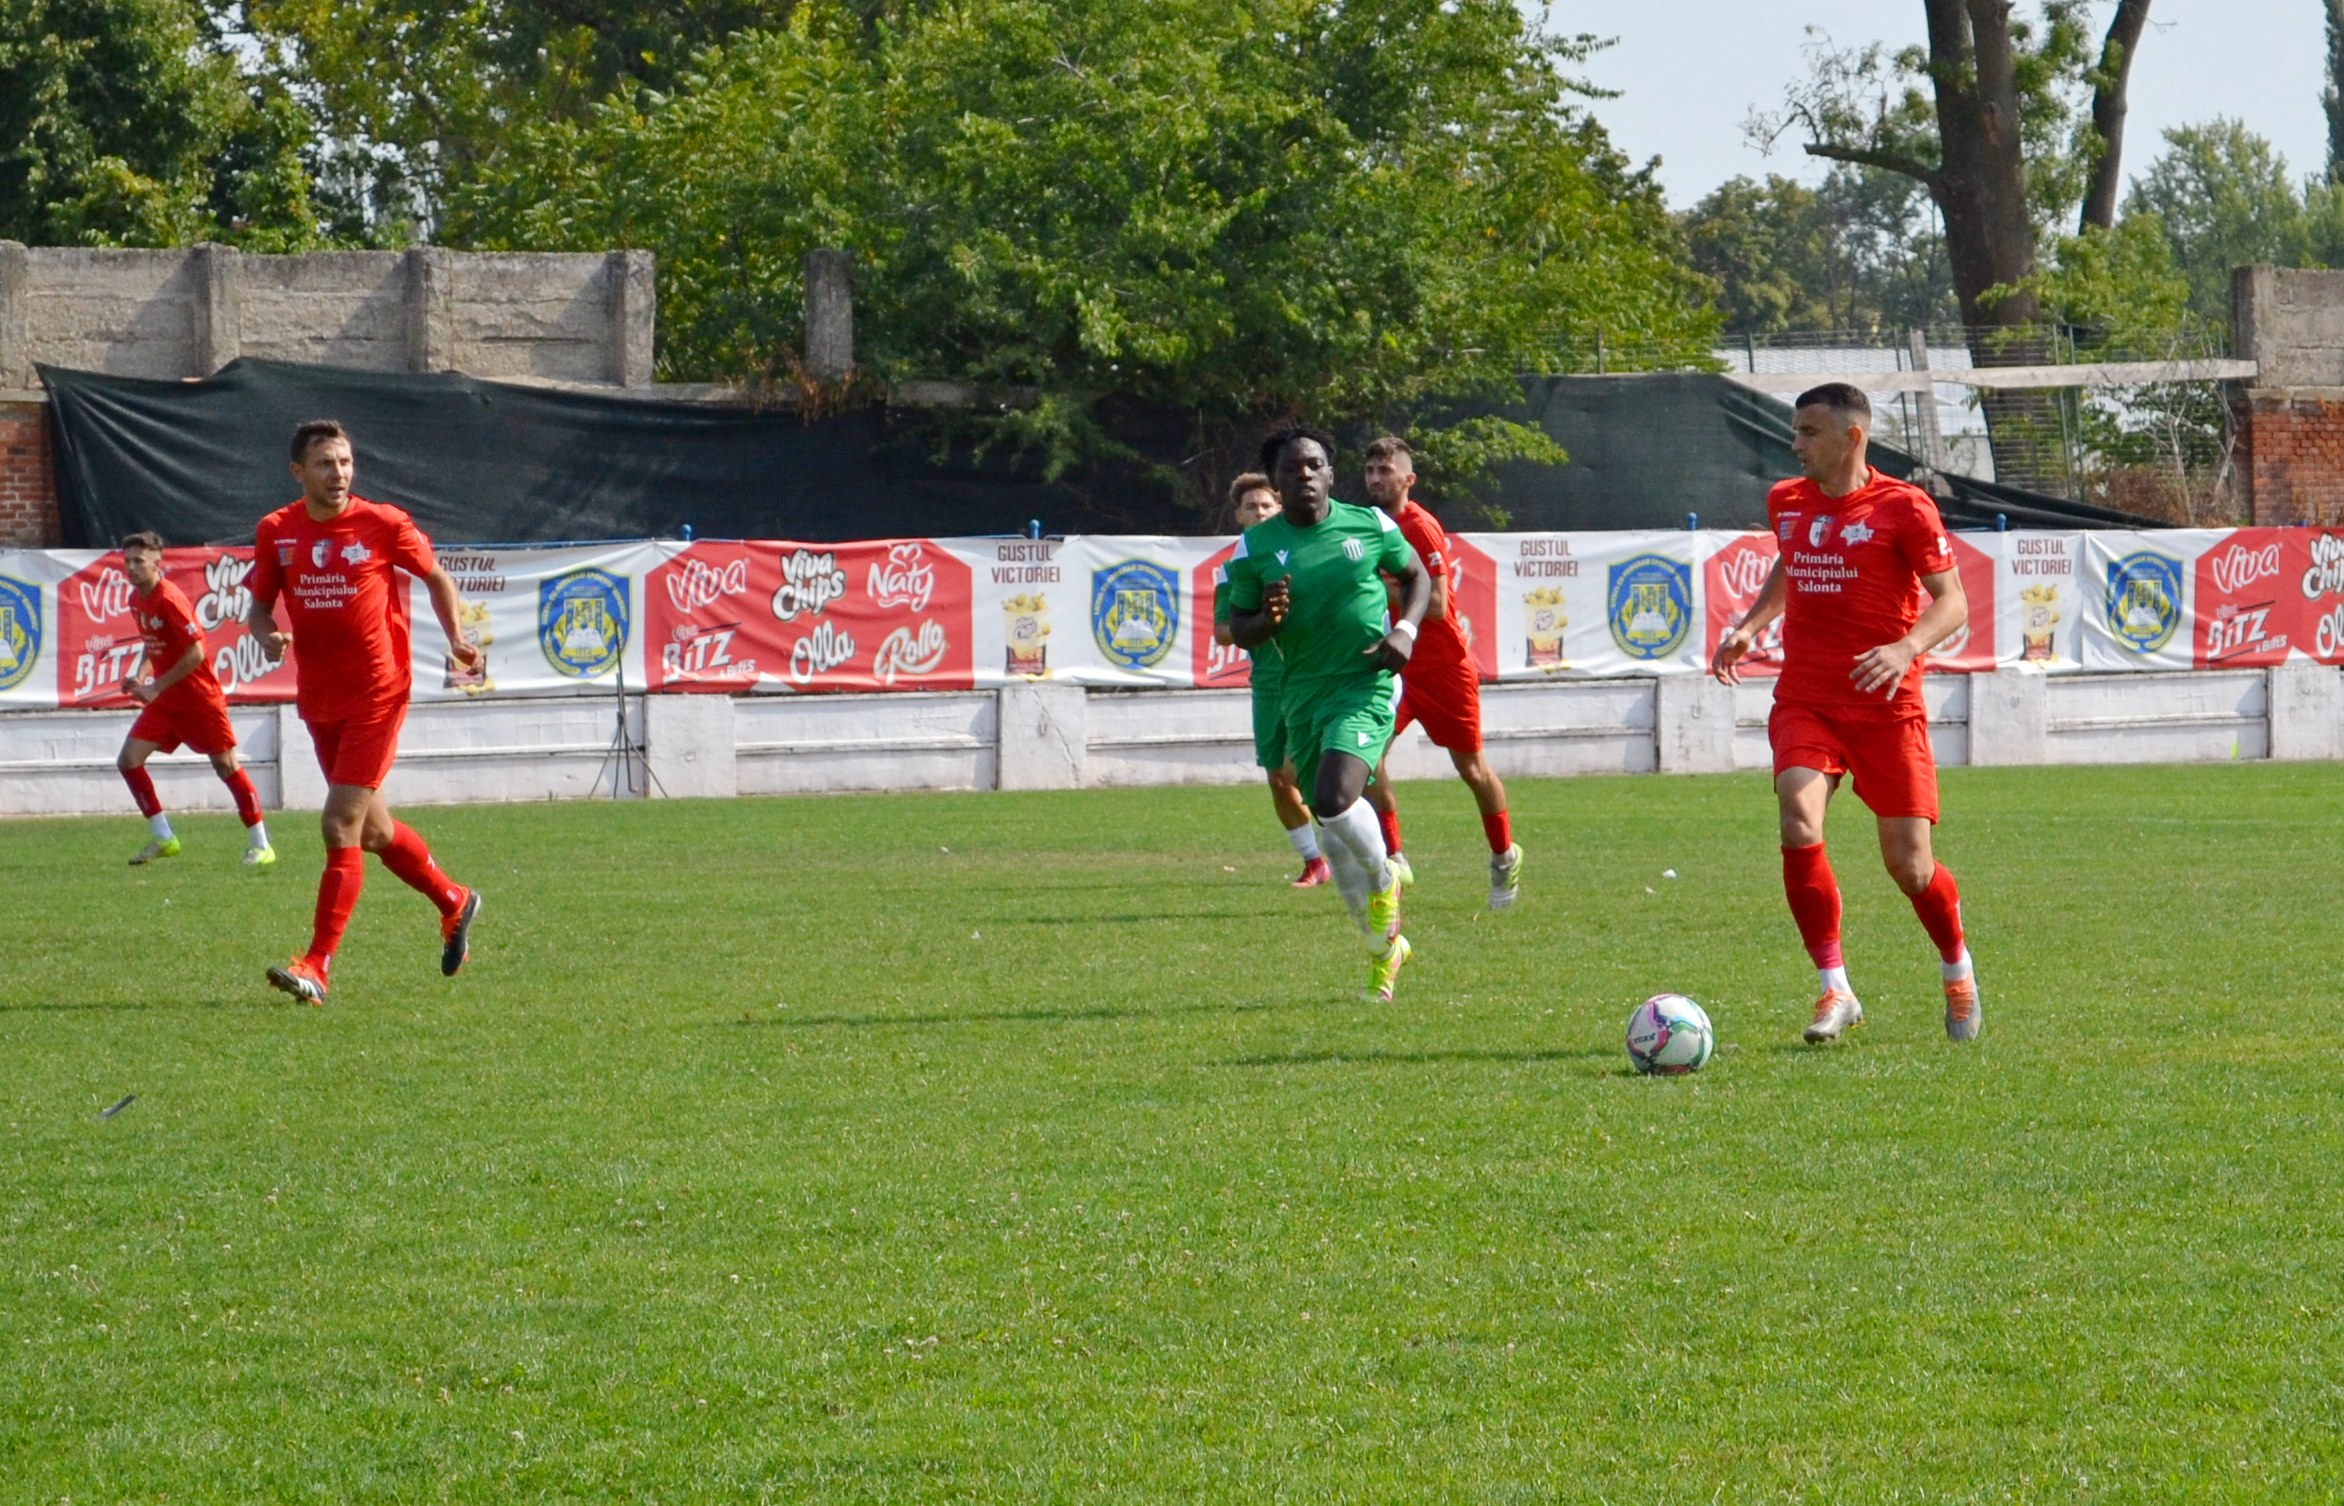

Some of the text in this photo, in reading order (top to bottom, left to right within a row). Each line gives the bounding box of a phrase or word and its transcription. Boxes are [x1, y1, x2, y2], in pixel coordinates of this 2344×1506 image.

[439, 556, 495, 572] GUSTUL
[997, 545, 1053, 562] GUSTUL
[1520, 540, 1571, 556] GUSTUL
[2015, 539, 2065, 555] GUSTUL
[2310, 532, 2344, 566] Viv
[780, 548, 834, 584] Viva
[991, 566, 1060, 584] VICTORIEI
[1514, 561, 1578, 577] VICTORIEI
[1721, 548, 1781, 599] Viv
[1785, 565, 1859, 581] Municipiului
[2011, 559, 2072, 575] VICTORIEI
[2212, 544, 2280, 594] Viva
[666, 558, 746, 614] Viva
[771, 570, 846, 621] Chips
[866, 559, 934, 613] Naty
[1797, 580, 1842, 593] Salonta
[194, 583, 253, 630] Chip
[303, 598, 343, 609] Salonta
[2316, 603, 2344, 658] Ol
[789, 619, 856, 684] Olla
[872, 618, 946, 685] Rollo
